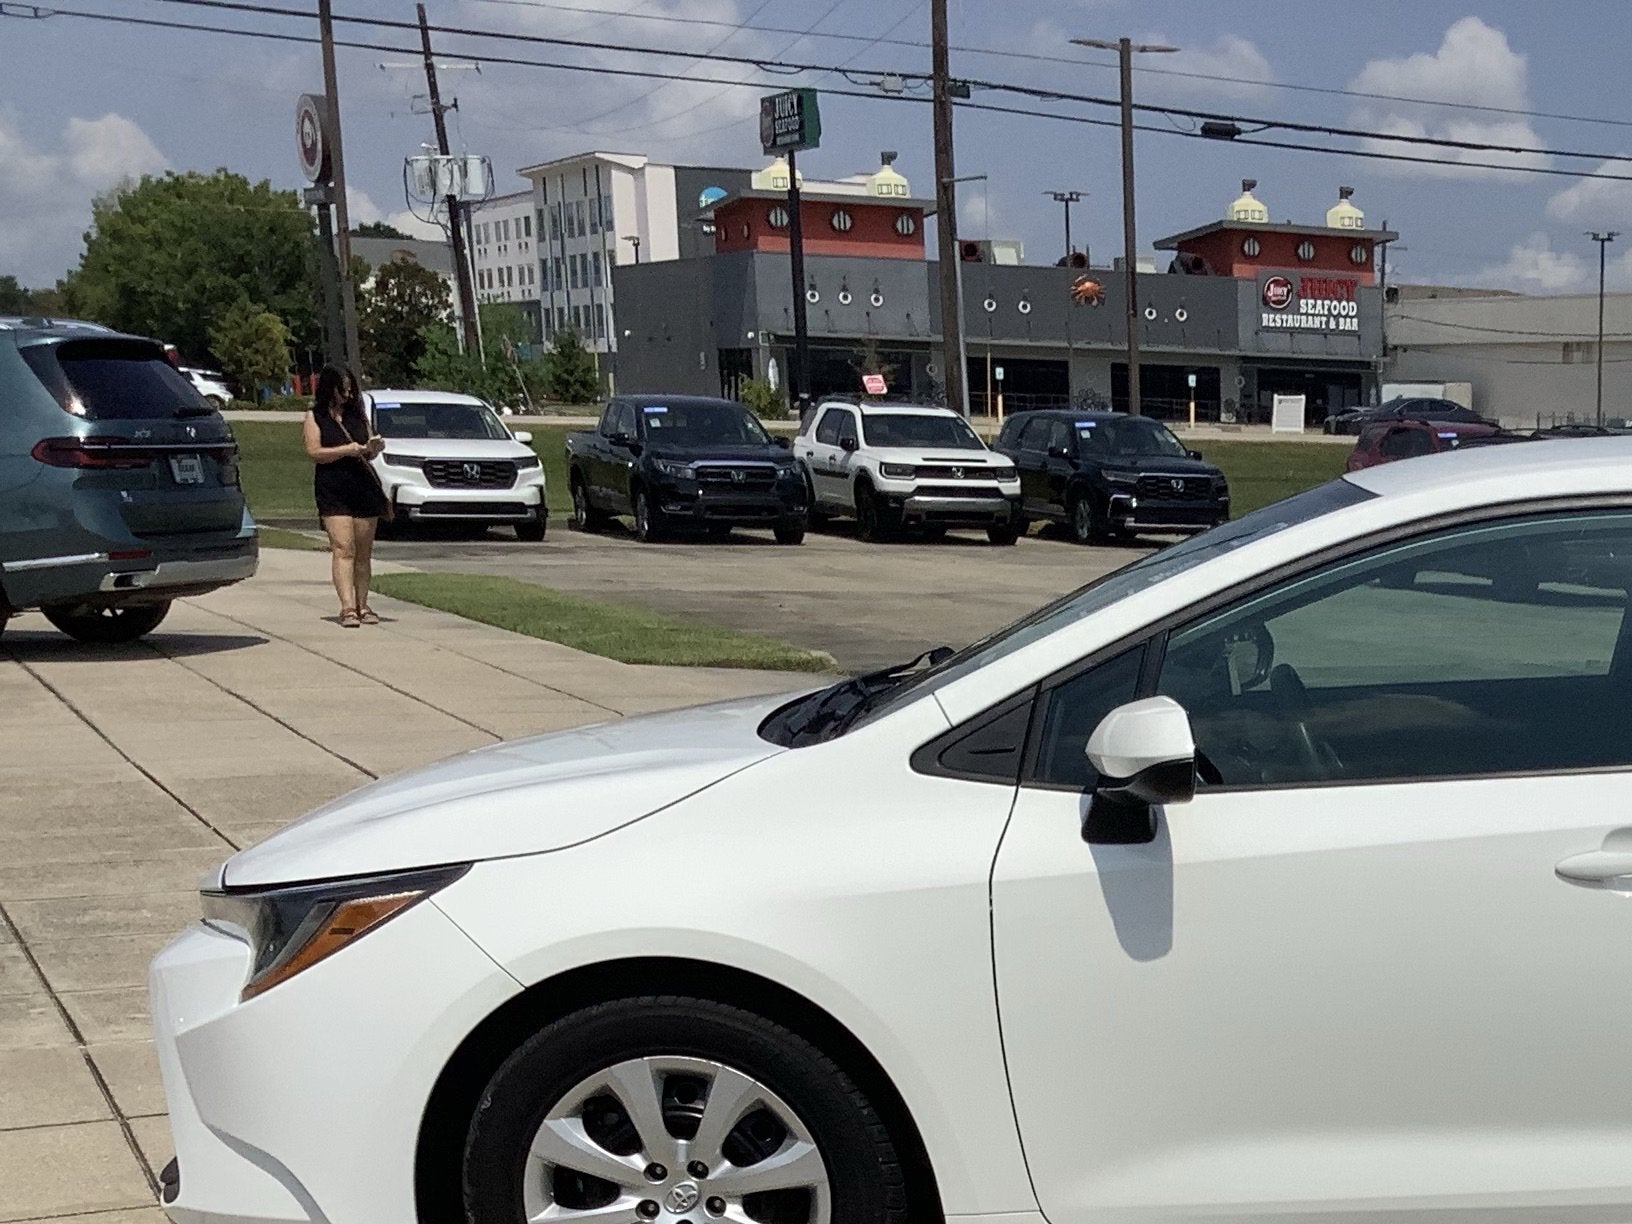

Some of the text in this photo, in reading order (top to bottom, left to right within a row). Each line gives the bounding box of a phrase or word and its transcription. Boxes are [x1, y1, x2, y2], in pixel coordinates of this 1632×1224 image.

[774, 93, 798, 118] JUICY
[1297, 277, 1357, 301] JUICY
[1299, 298, 1358, 316] SEAFOOD
[1262, 313, 1359, 331] RESTAURANT & BAR
